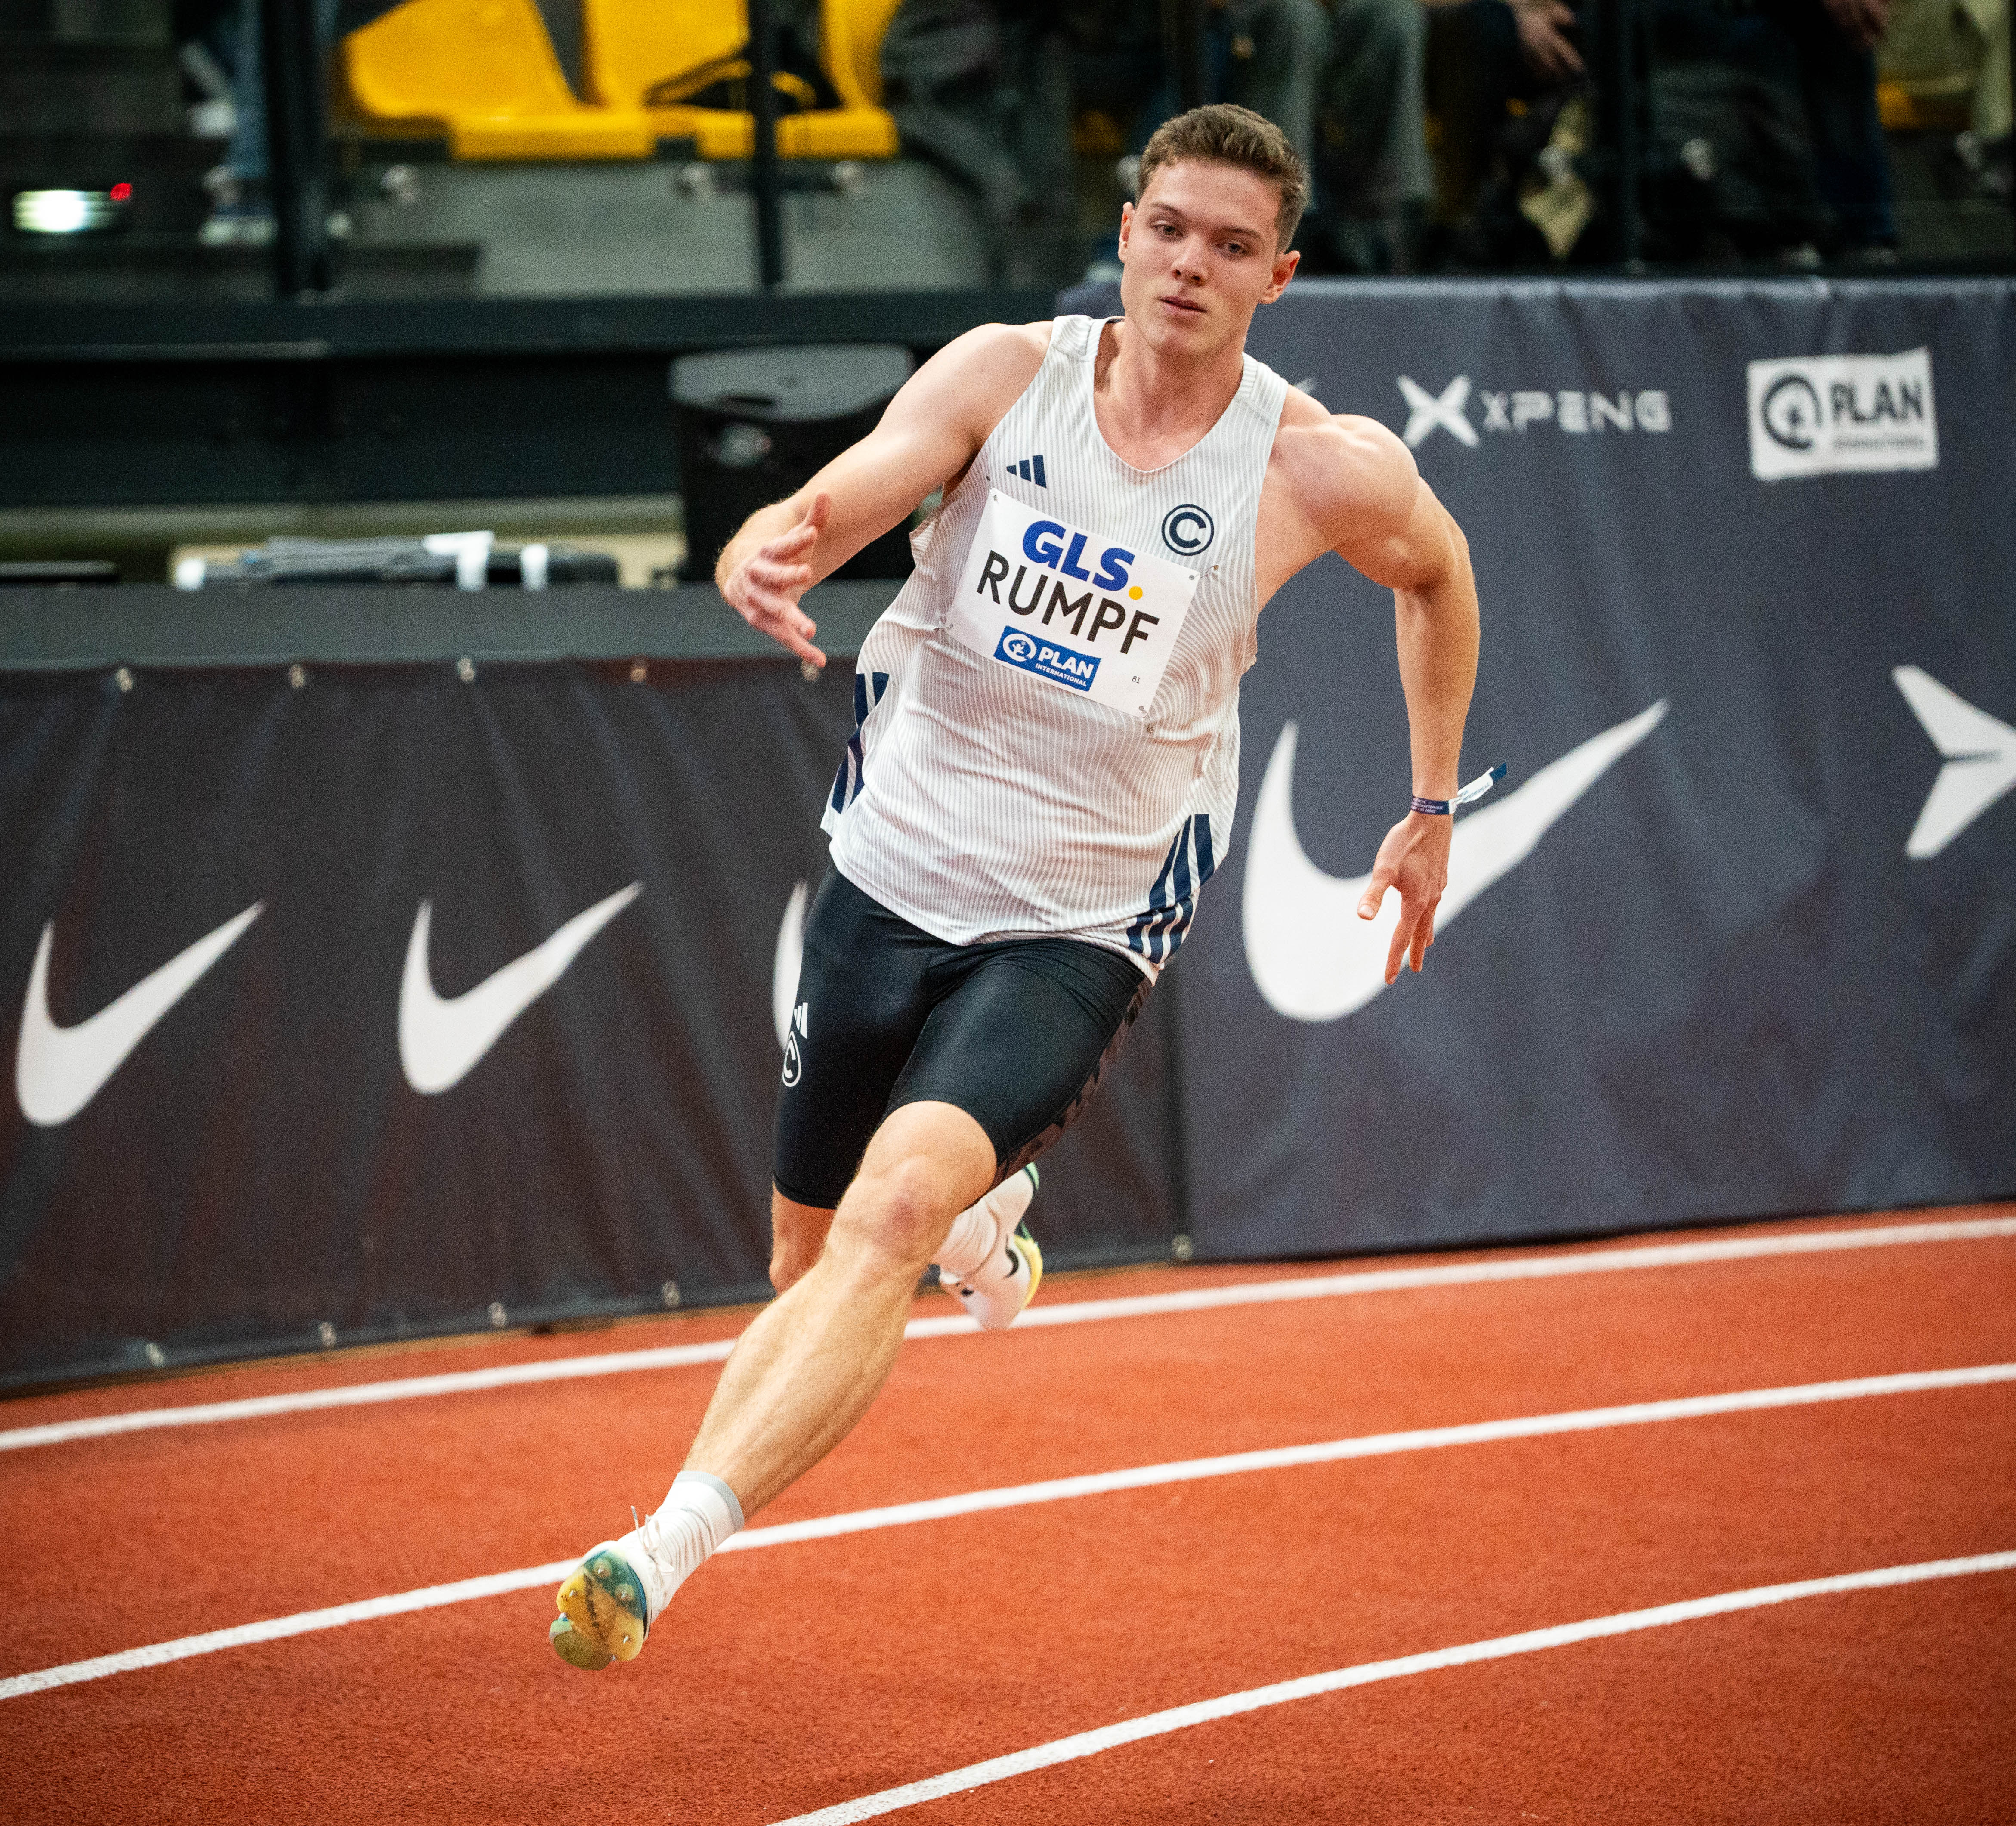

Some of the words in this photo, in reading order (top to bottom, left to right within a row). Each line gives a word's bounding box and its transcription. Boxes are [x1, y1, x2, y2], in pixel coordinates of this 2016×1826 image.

[1481, 390, 1670, 432] XPENG
[1830, 380, 1923, 424] PLAN
[976, 550, 1160, 654] RUMPF
[1035, 663, 1087, 687] INTERNATIONAL
[1038, 647, 1094, 679] PLAN
[1132, 675, 1140, 684] 81
